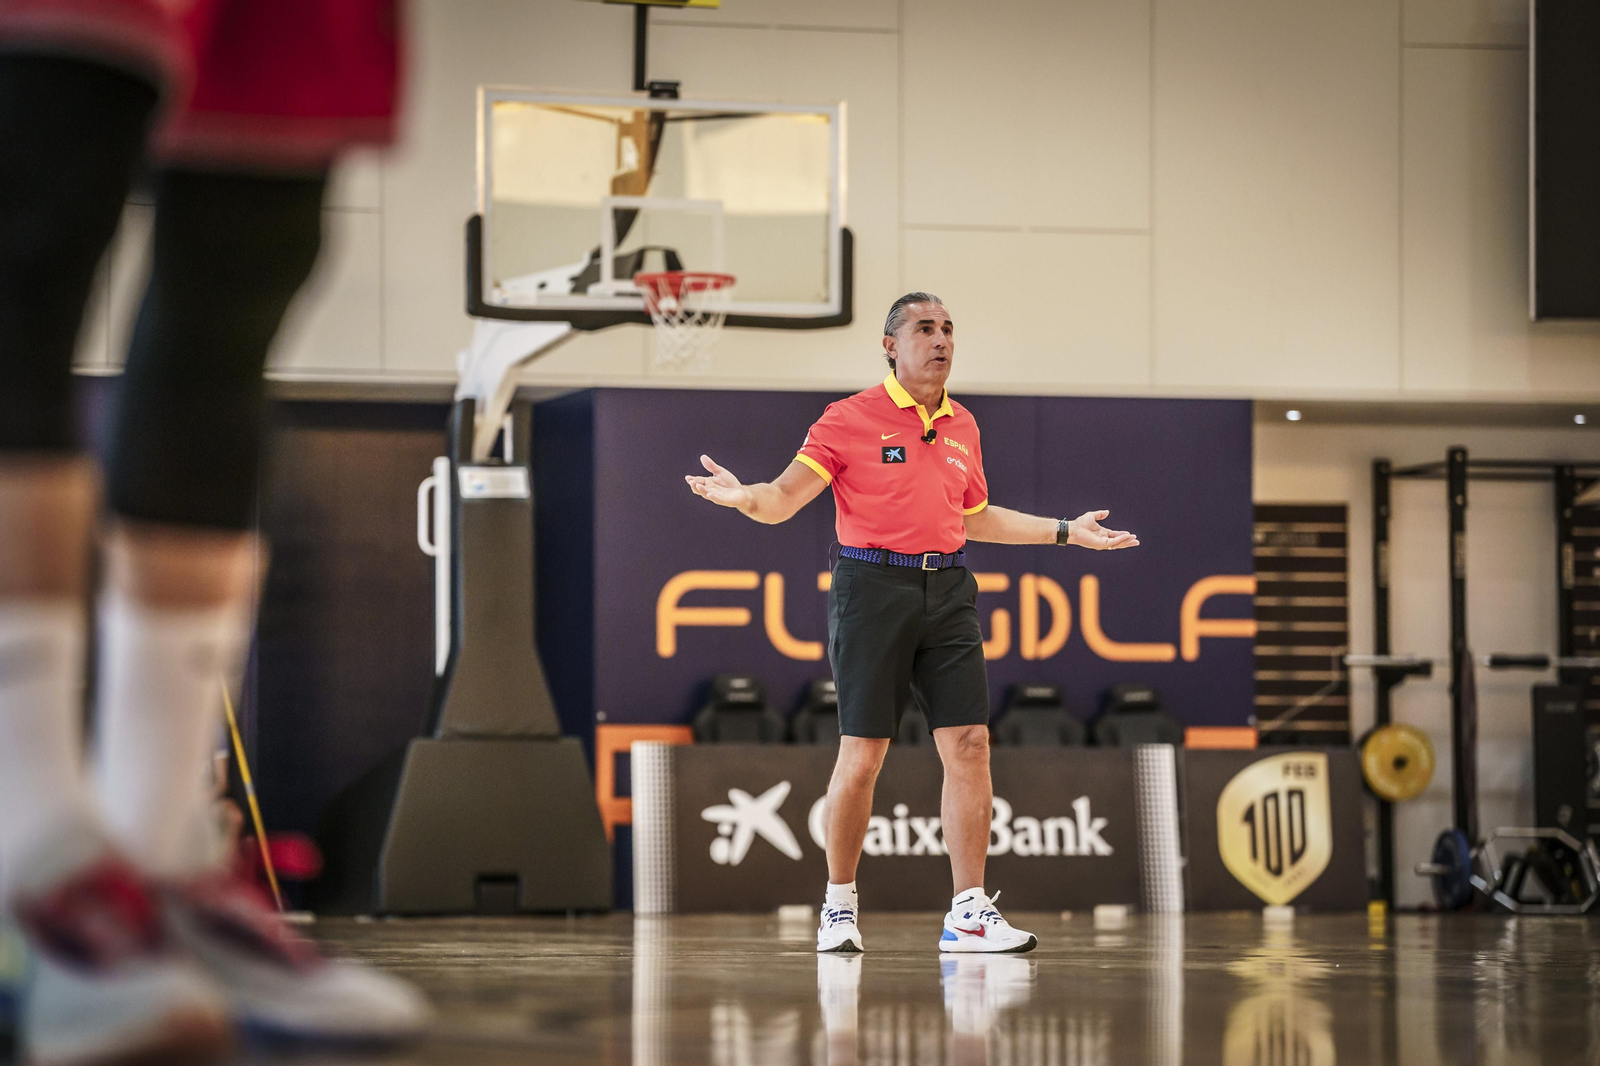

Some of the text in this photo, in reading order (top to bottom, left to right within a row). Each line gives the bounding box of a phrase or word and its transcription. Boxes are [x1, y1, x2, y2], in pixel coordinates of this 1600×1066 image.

[944, 436, 969, 456] ESPAÑA
[808, 795, 1114, 857] aixBank
[1242, 789, 1306, 877] 100
